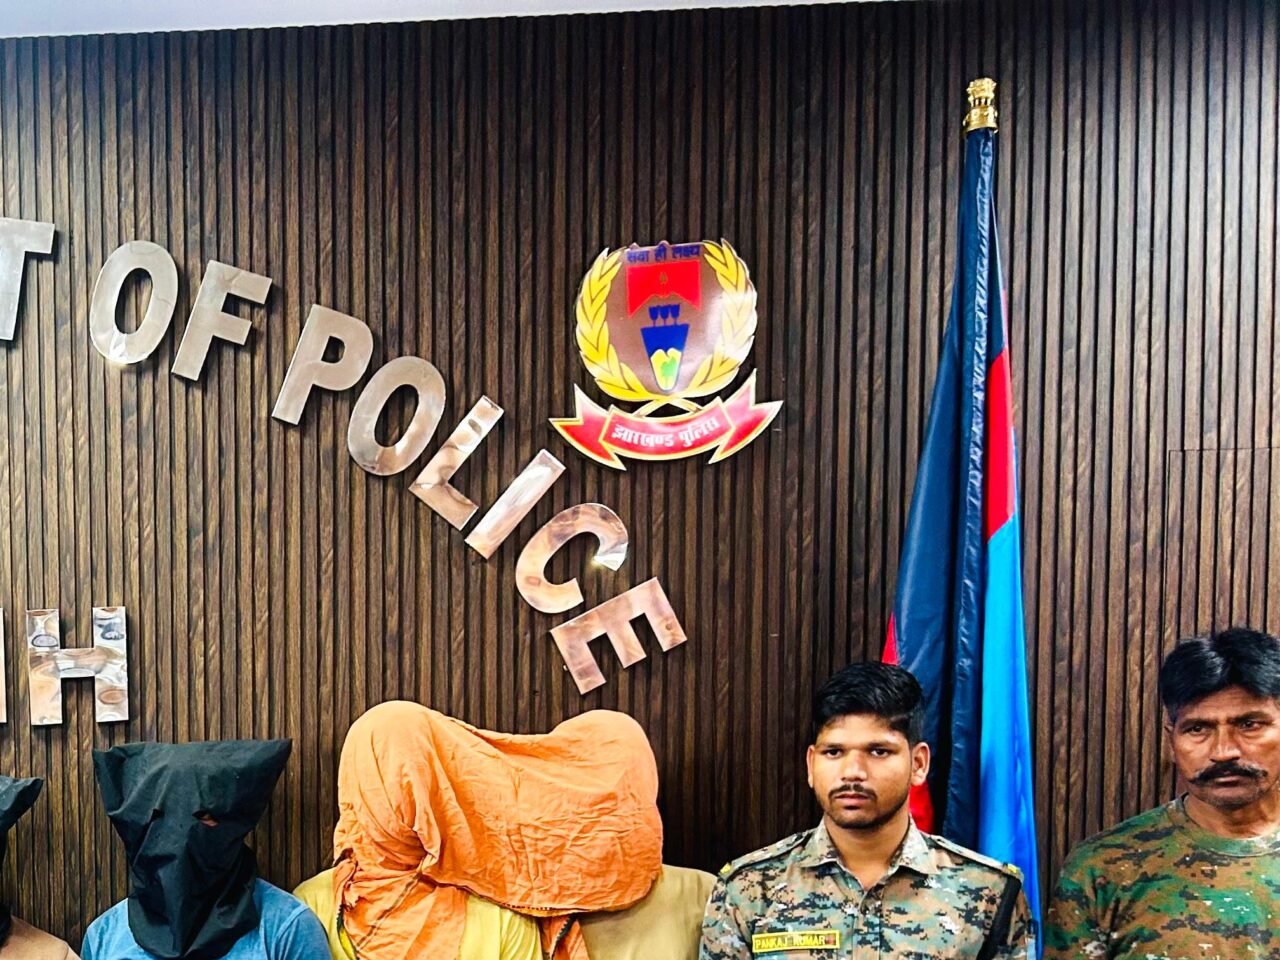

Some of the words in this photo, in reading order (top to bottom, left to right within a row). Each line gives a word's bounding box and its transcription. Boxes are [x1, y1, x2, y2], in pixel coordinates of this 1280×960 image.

[89, 240, 273, 381] OF
[271, 304, 688, 696] POLICE
[611, 424, 674, 447] झारखण्ड
[677, 418, 720, 448] पुलिस
